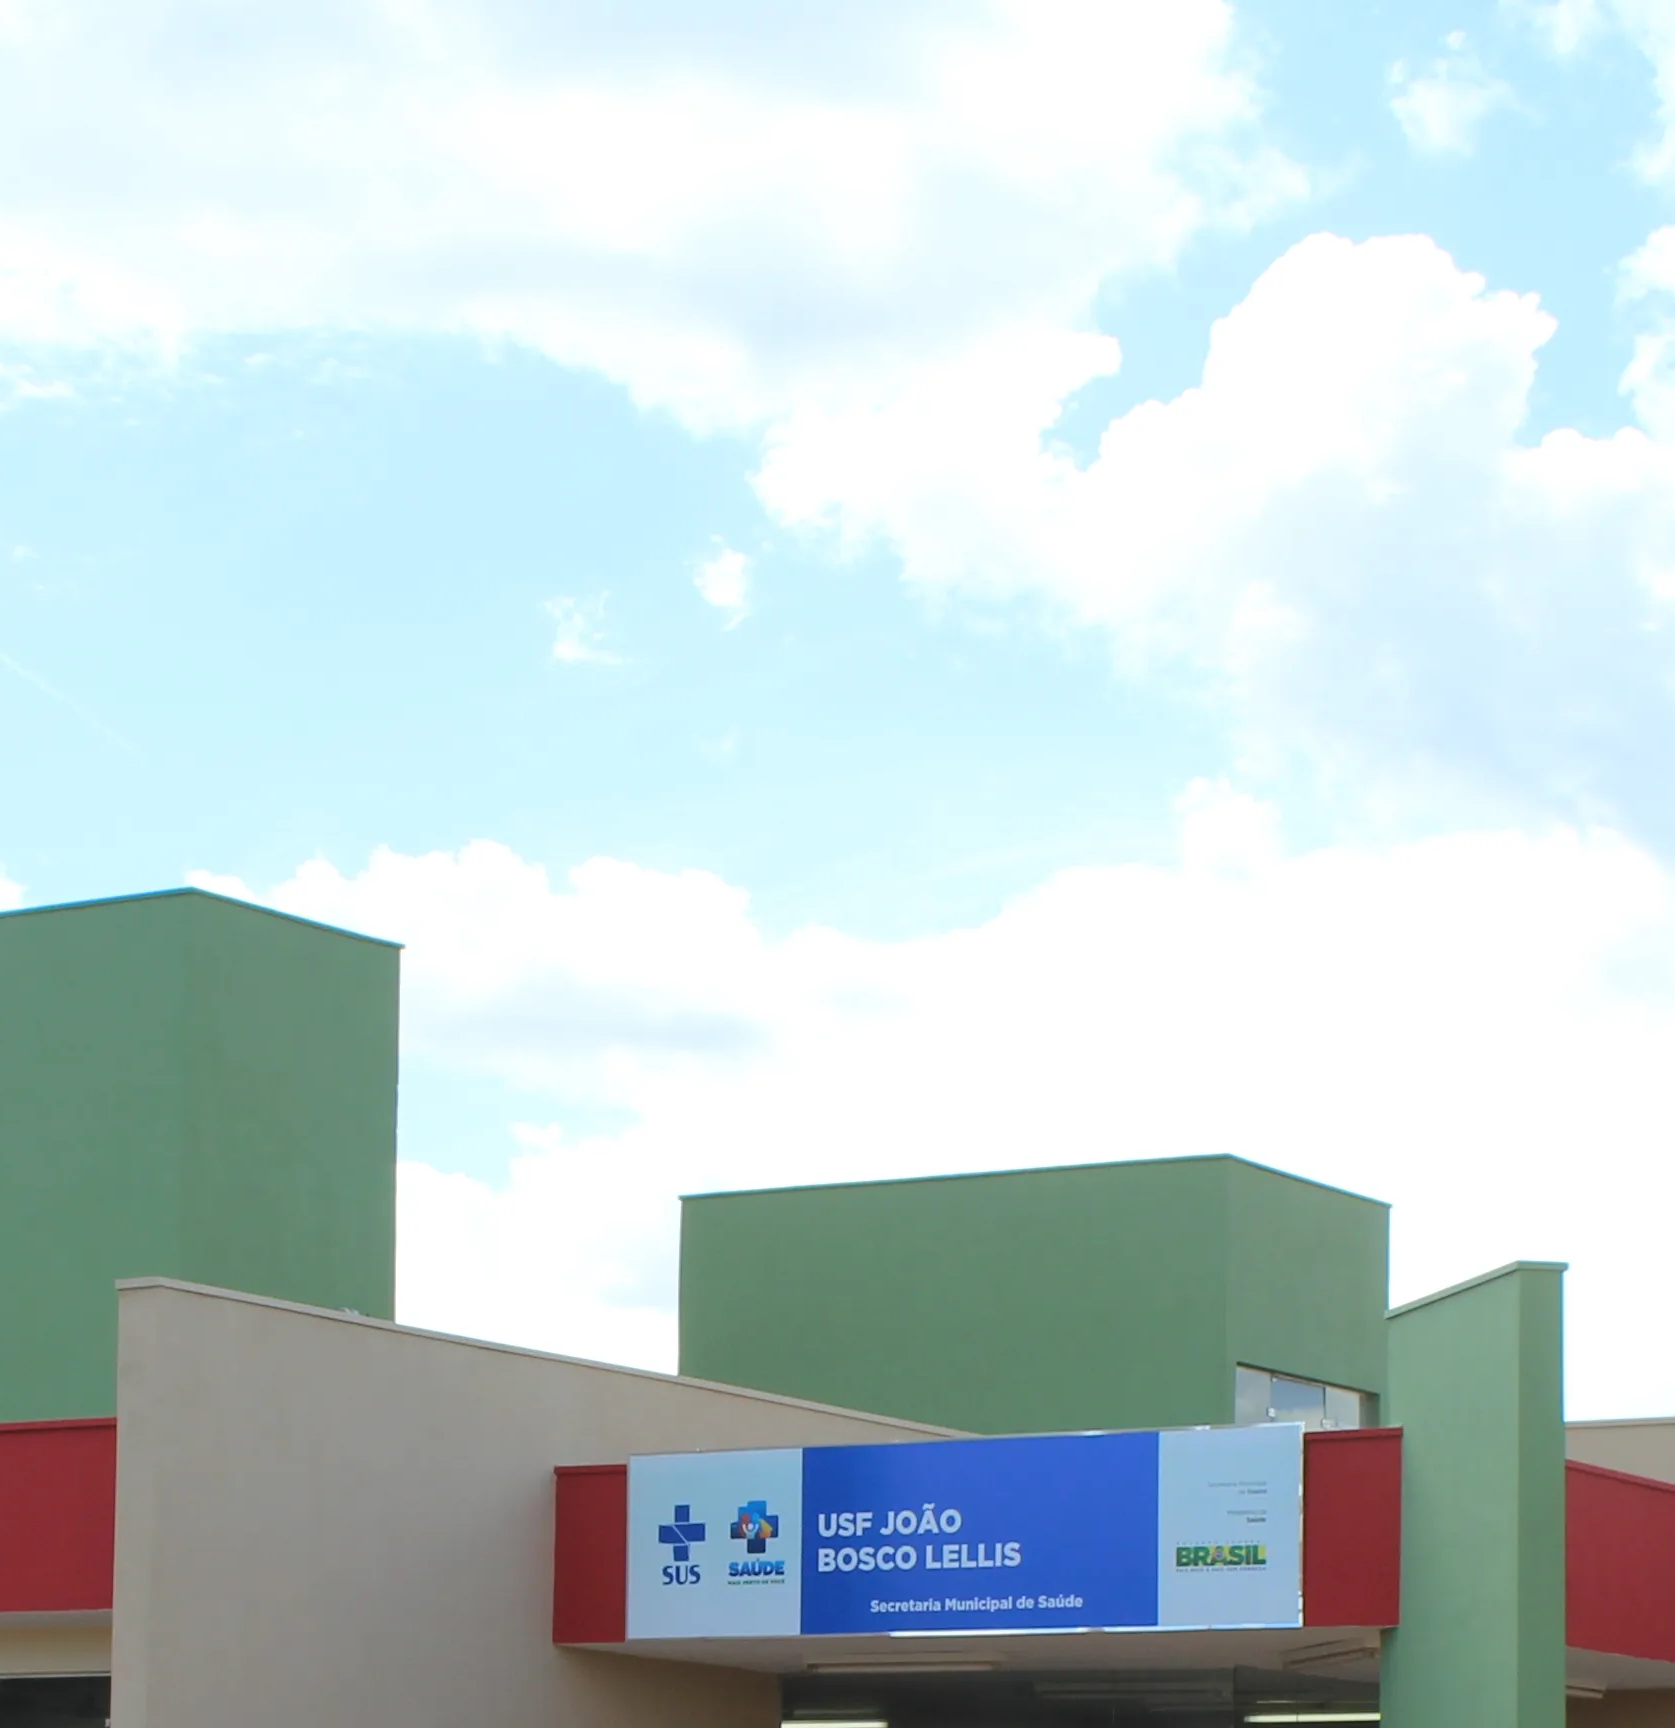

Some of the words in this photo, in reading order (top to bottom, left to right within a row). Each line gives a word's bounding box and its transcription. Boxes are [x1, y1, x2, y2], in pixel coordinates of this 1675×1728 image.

[817, 1511, 873, 1538] USF
[879, 1503, 962, 1536] JOÃO
[817, 1545, 918, 1573] BOSCO
[925, 1542, 1022, 1570] LELLIS
[1175, 1545, 1267, 1567] BRASIL
[662, 1564, 701, 1586] SUS
[728, 1558, 785, 1577] SAÚDE
[870, 1597, 942, 1613] Secretaria
[944, 1596, 1013, 1612] Municipal
[1016, 1595, 1034, 1609] de
[1037, 1593, 1084, 1609] Saúde
